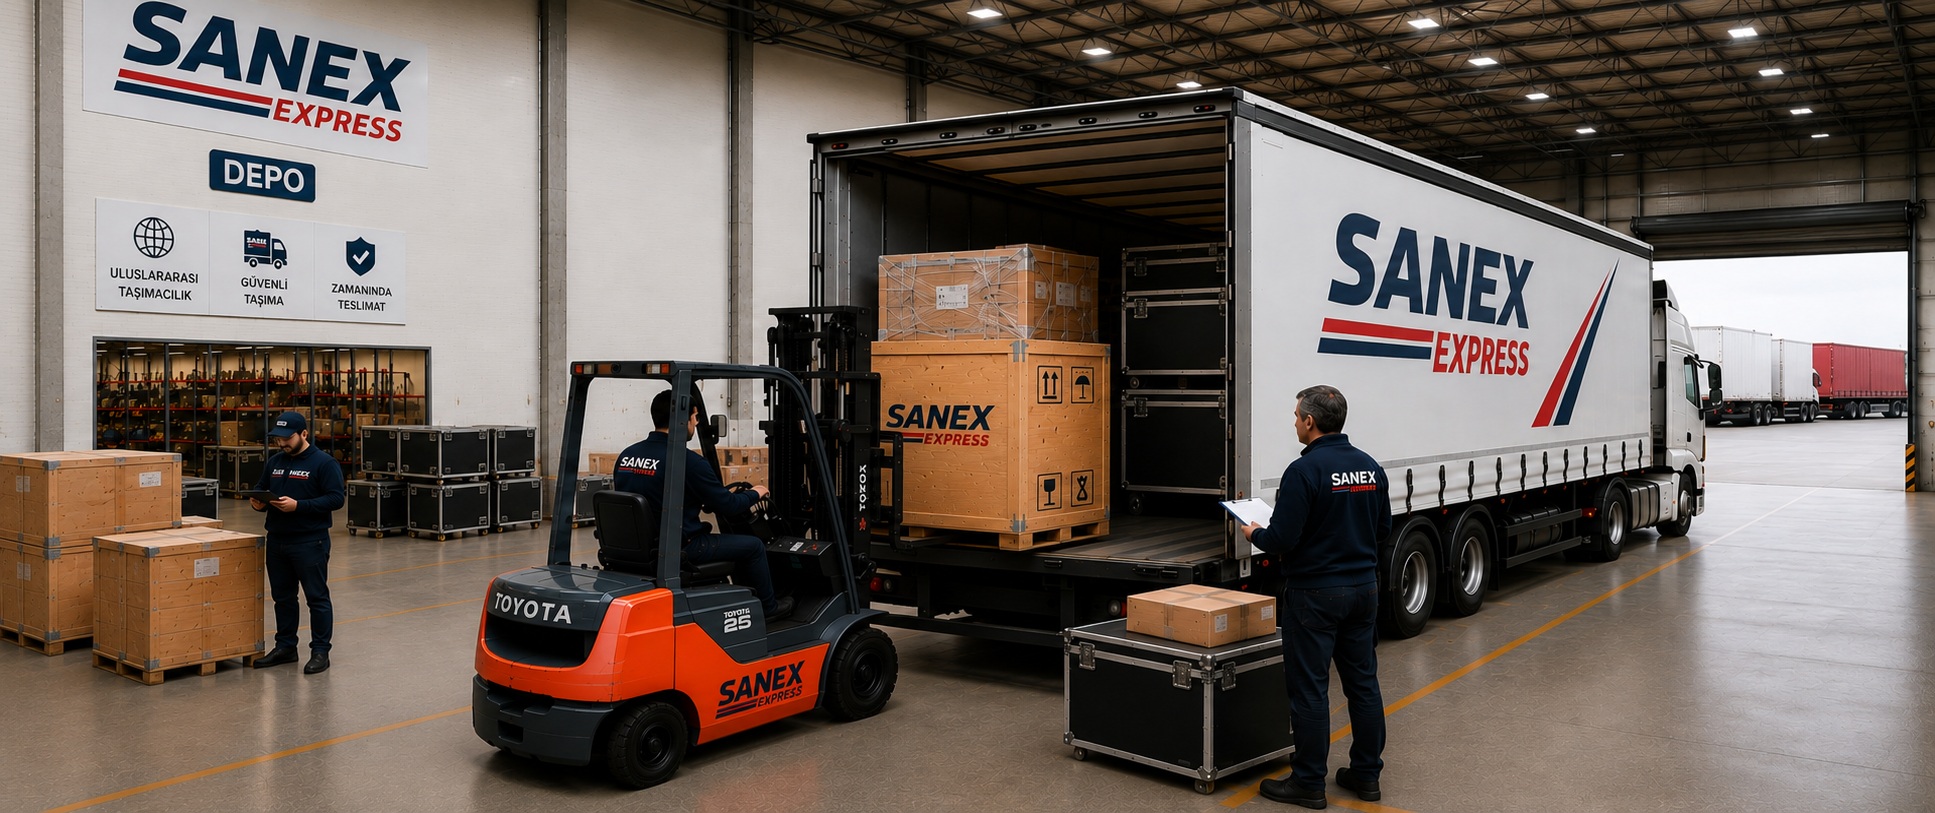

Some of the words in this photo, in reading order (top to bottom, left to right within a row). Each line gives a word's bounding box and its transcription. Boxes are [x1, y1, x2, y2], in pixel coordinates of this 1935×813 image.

[123, 1, 411, 112] SANEX
[272, 98, 403, 142] EXPRESS
[223, 158, 306, 193] DEPO
[110, 267, 199, 284] ULUSLARARASI
[1328, 212, 1534, 329] SANEX
[118, 286, 192, 300] TAŞIMACILIK
[244, 294, 284, 307] TAŞIMA
[331, 283, 393, 297] ZAMANINDA
[337, 300, 386, 311] TESLIMAT
[1432, 331, 1530, 376] EXPRESS
[886, 404, 996, 431] SANEX
[924, 433, 990, 447] EXPRESS
[620, 456, 660, 470] SANEX
[1331, 471, 1376, 486] SANEX
[494, 592, 572, 625] TOYOTA
[724, 614, 752, 633] 25
[718, 660, 806, 707] SANEX
[757, 685, 803, 708] EXPRESS
